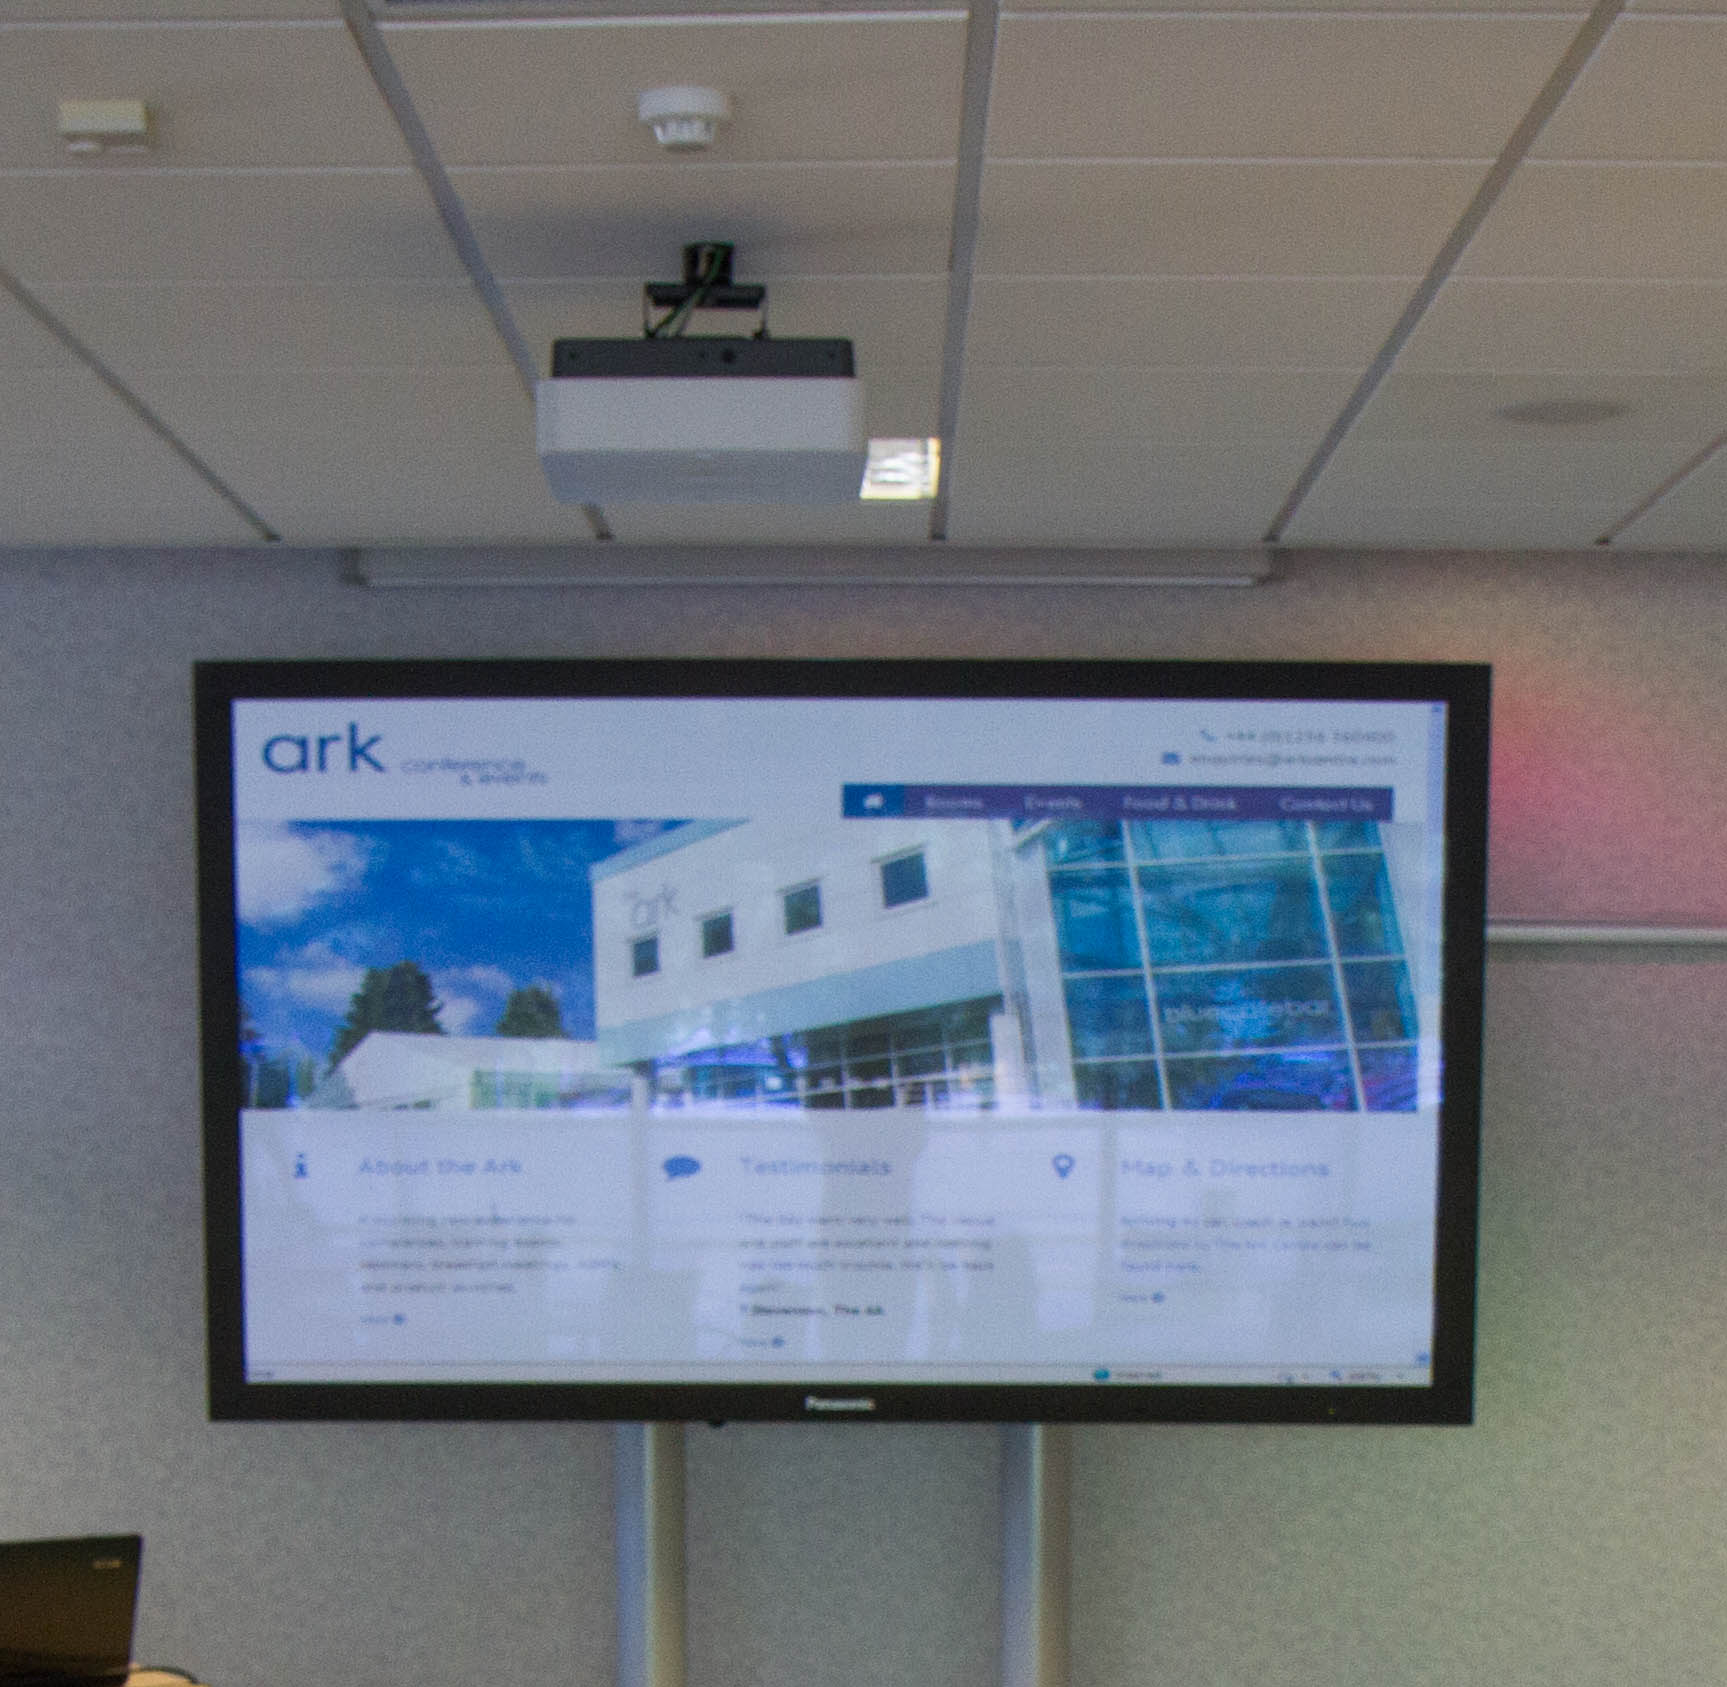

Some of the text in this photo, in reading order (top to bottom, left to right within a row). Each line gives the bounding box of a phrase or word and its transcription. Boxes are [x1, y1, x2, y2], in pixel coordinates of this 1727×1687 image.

[262, 721, 385, 774] ark
[358, 1157, 523, 1176] About the Ark
[740, 1157, 892, 1177] Testimonials
[1122, 1158, 1330, 1180] Map & Directions
